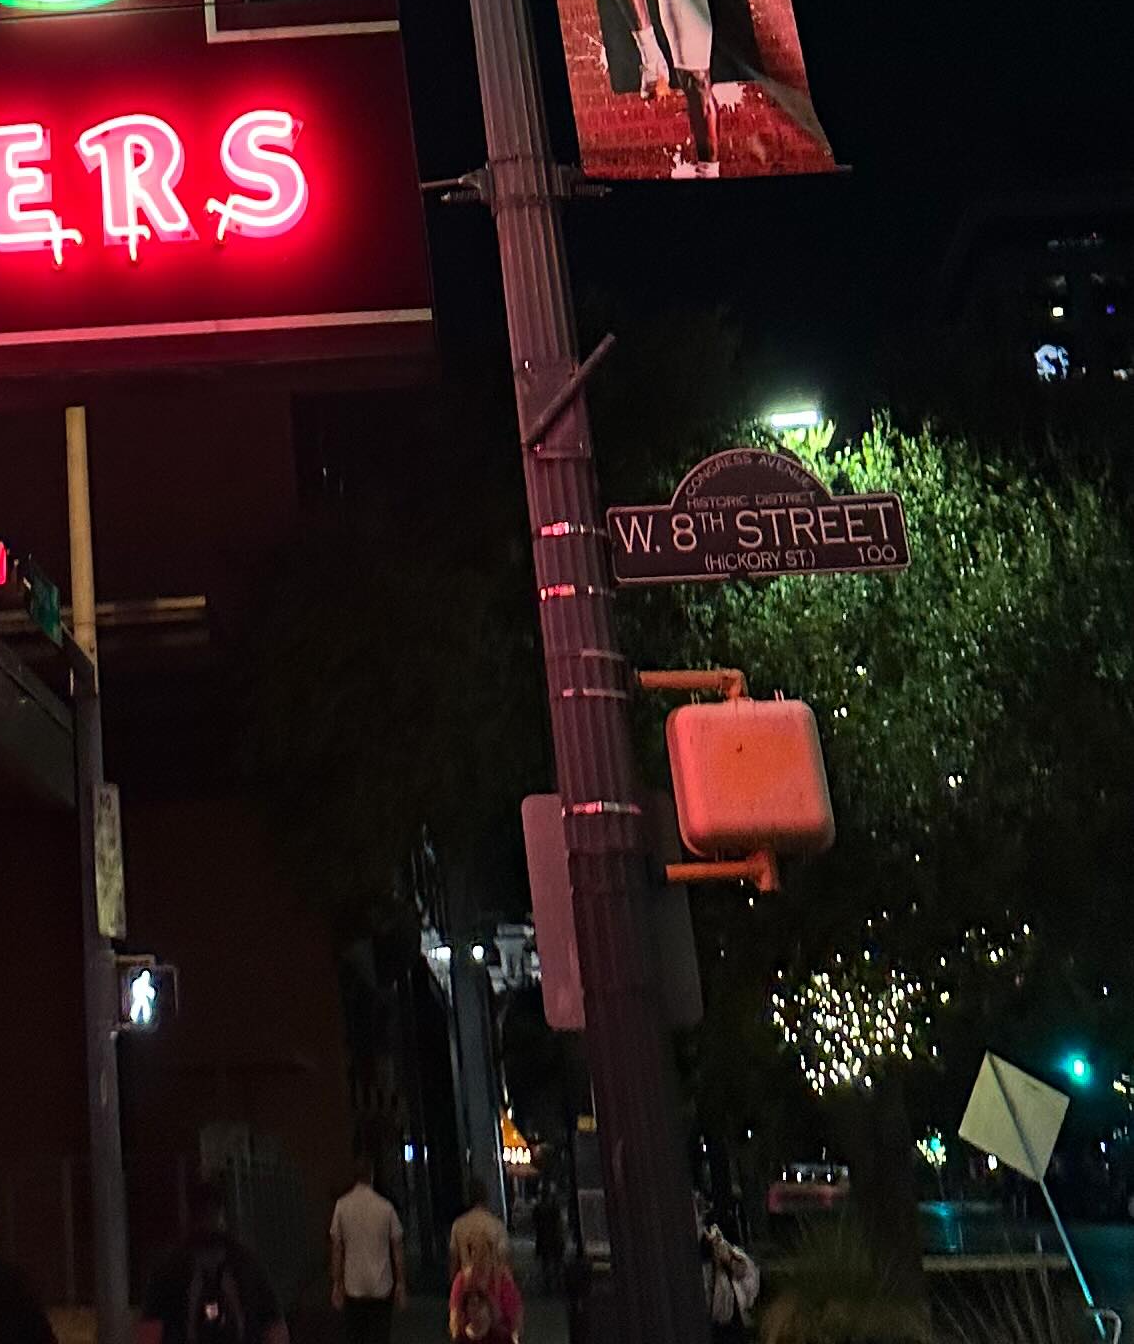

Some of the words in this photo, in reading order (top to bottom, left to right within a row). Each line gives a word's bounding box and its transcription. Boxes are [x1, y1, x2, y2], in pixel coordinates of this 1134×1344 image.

[685, 453, 753, 497] CONGRESS
[757, 456, 815, 489] AVENUE
[686, 494, 749, 510] HISTORIC
[755, 490, 818, 506] DISTRICT
[615, 515, 662, 554] W.
[671, 511, 726, 552] 8TH
[735, 502, 895, 549] STREET
[704, 551, 781, 573] (HICKORY
[857, 544, 897, 564] 100
